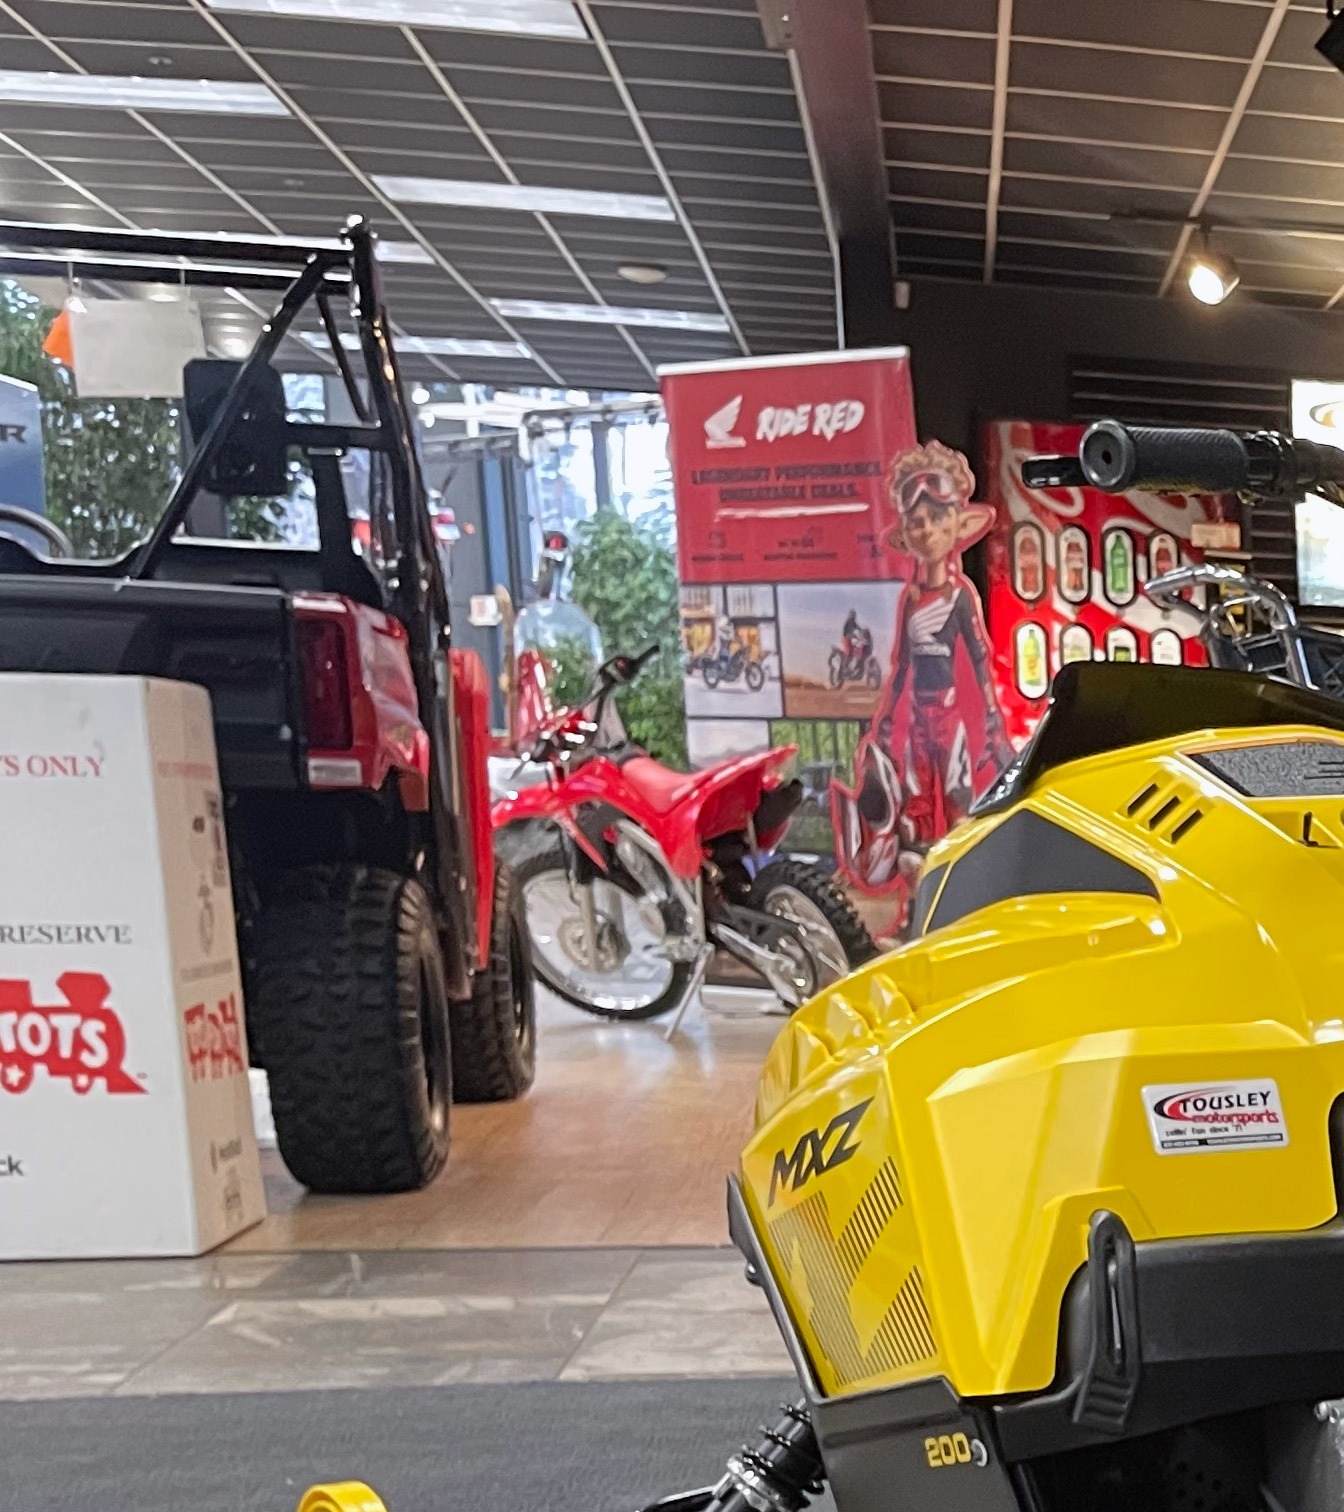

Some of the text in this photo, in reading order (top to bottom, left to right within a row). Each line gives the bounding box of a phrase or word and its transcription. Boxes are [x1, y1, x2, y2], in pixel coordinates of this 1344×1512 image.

[756, 399, 865, 443] RIDE RED
[27, 755, 104, 778] ONLY
[0, 924, 132, 944] RESERVE
[1179, 1091, 1271, 1113] TOUSLEY
[1191, 1109, 1279, 1126] motorsports
[767, 1095, 875, 1209] MXZ
[925, 1432, 971, 1467] 200
